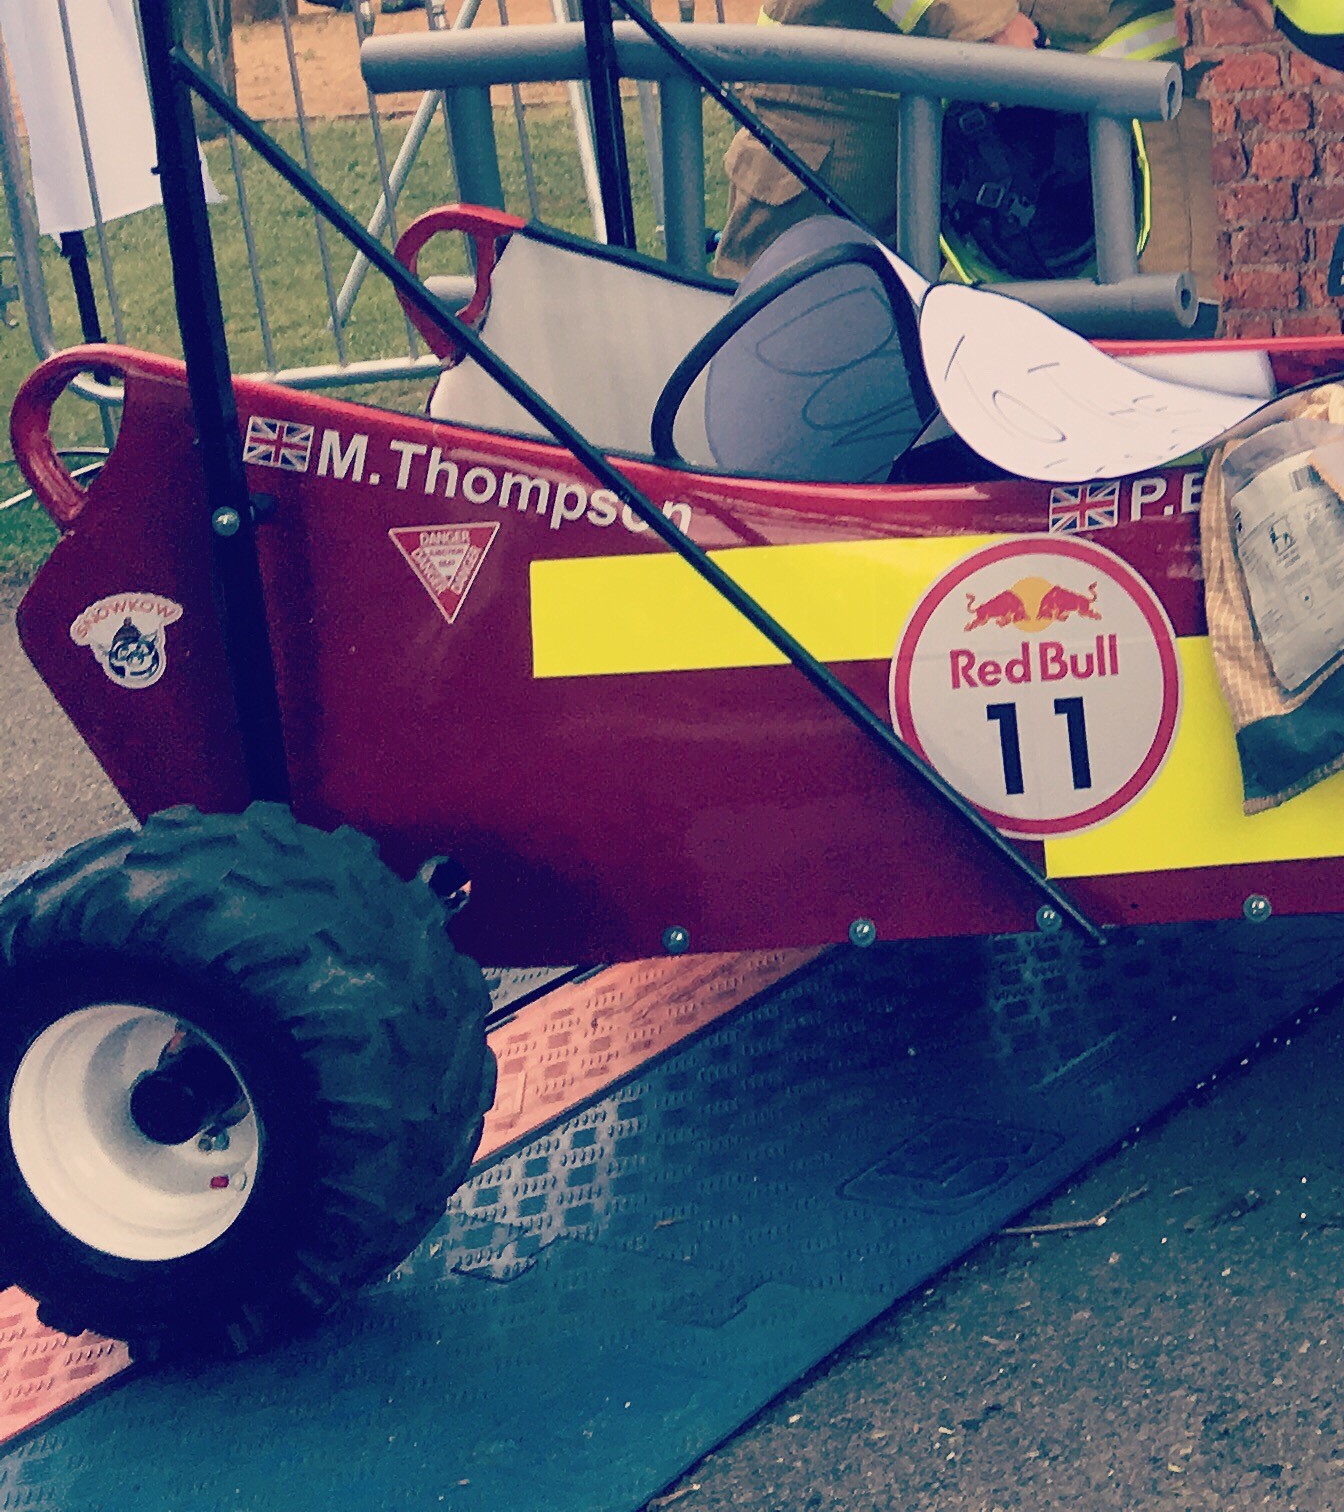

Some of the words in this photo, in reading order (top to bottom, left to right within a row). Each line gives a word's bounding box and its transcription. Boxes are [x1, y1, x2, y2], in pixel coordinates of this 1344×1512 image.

[949, 641, 1032, 690] Red
[1039, 633, 1119, 682] Bull
[986, 696, 1092, 795] 11
